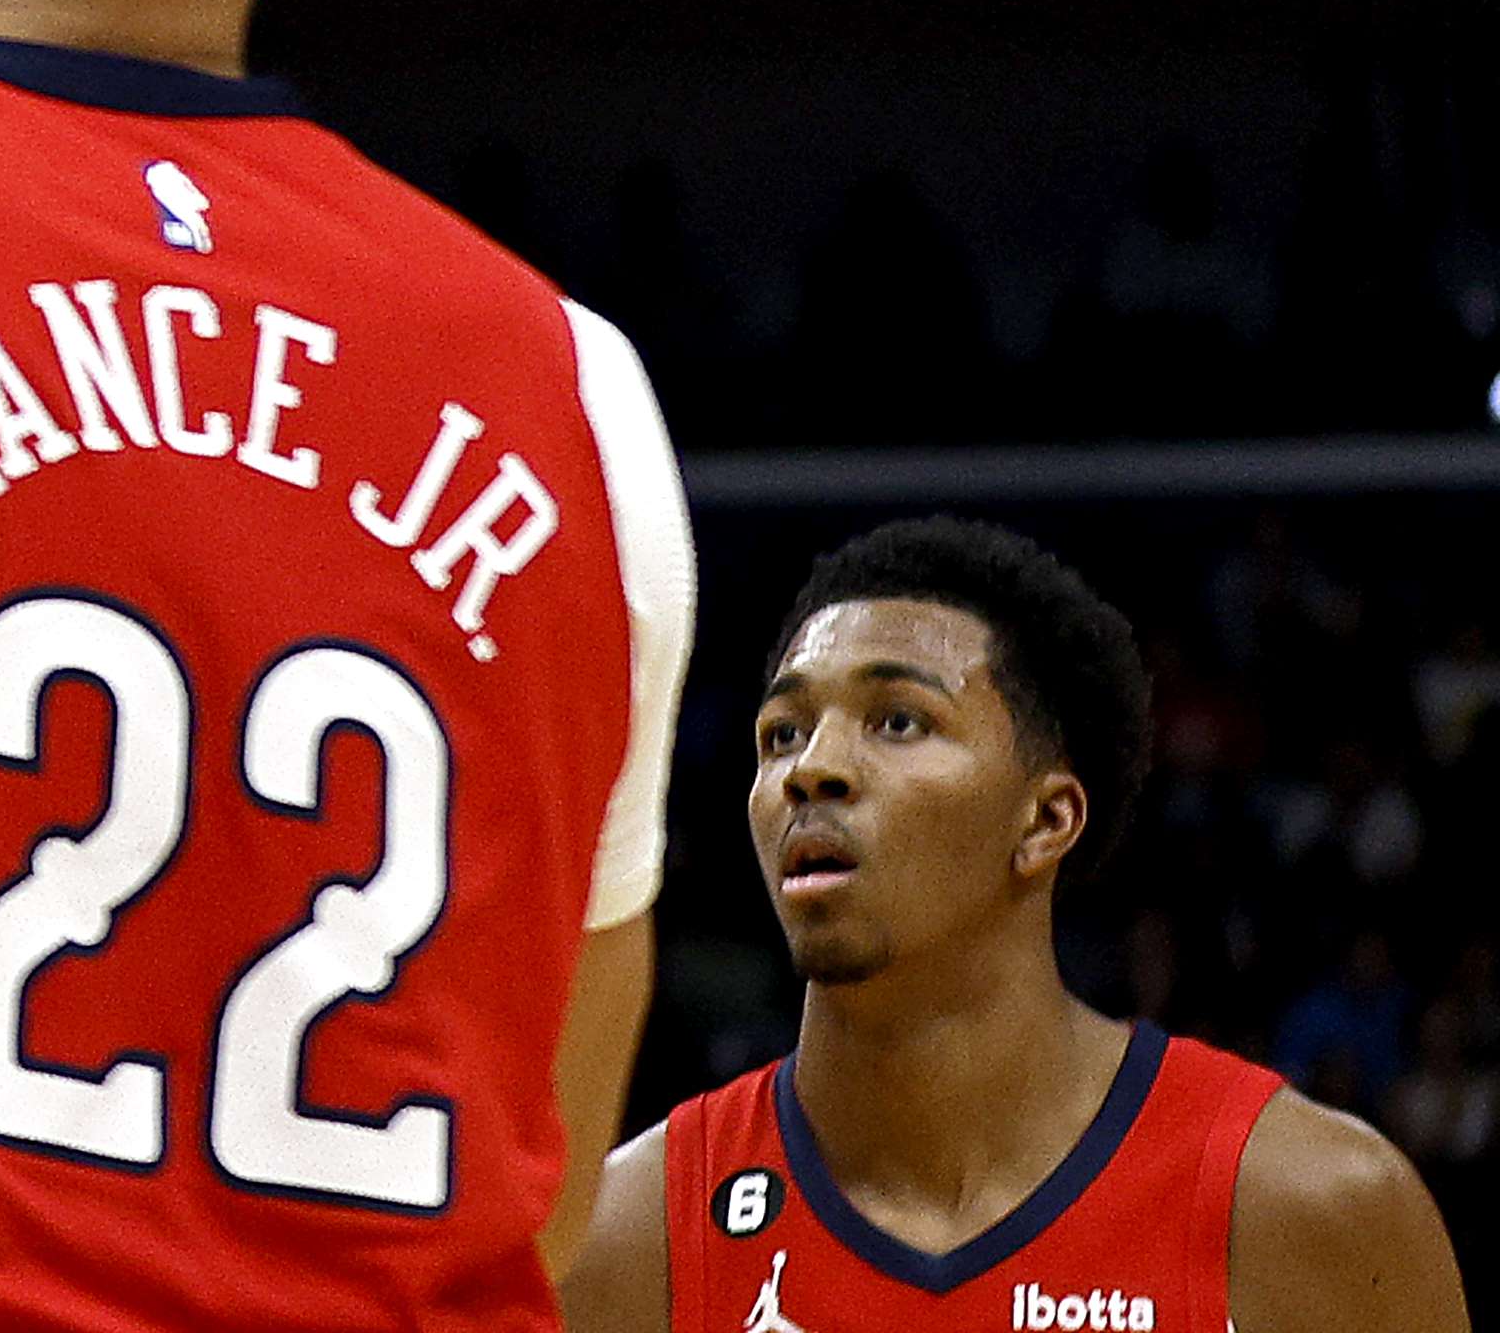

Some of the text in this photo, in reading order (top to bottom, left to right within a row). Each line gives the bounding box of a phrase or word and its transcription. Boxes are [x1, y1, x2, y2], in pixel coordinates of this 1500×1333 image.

[348, 401, 560, 664] JR.
[726, 1173, 769, 1235] 6
[1013, 1283, 1156, 1332] Ibotta
